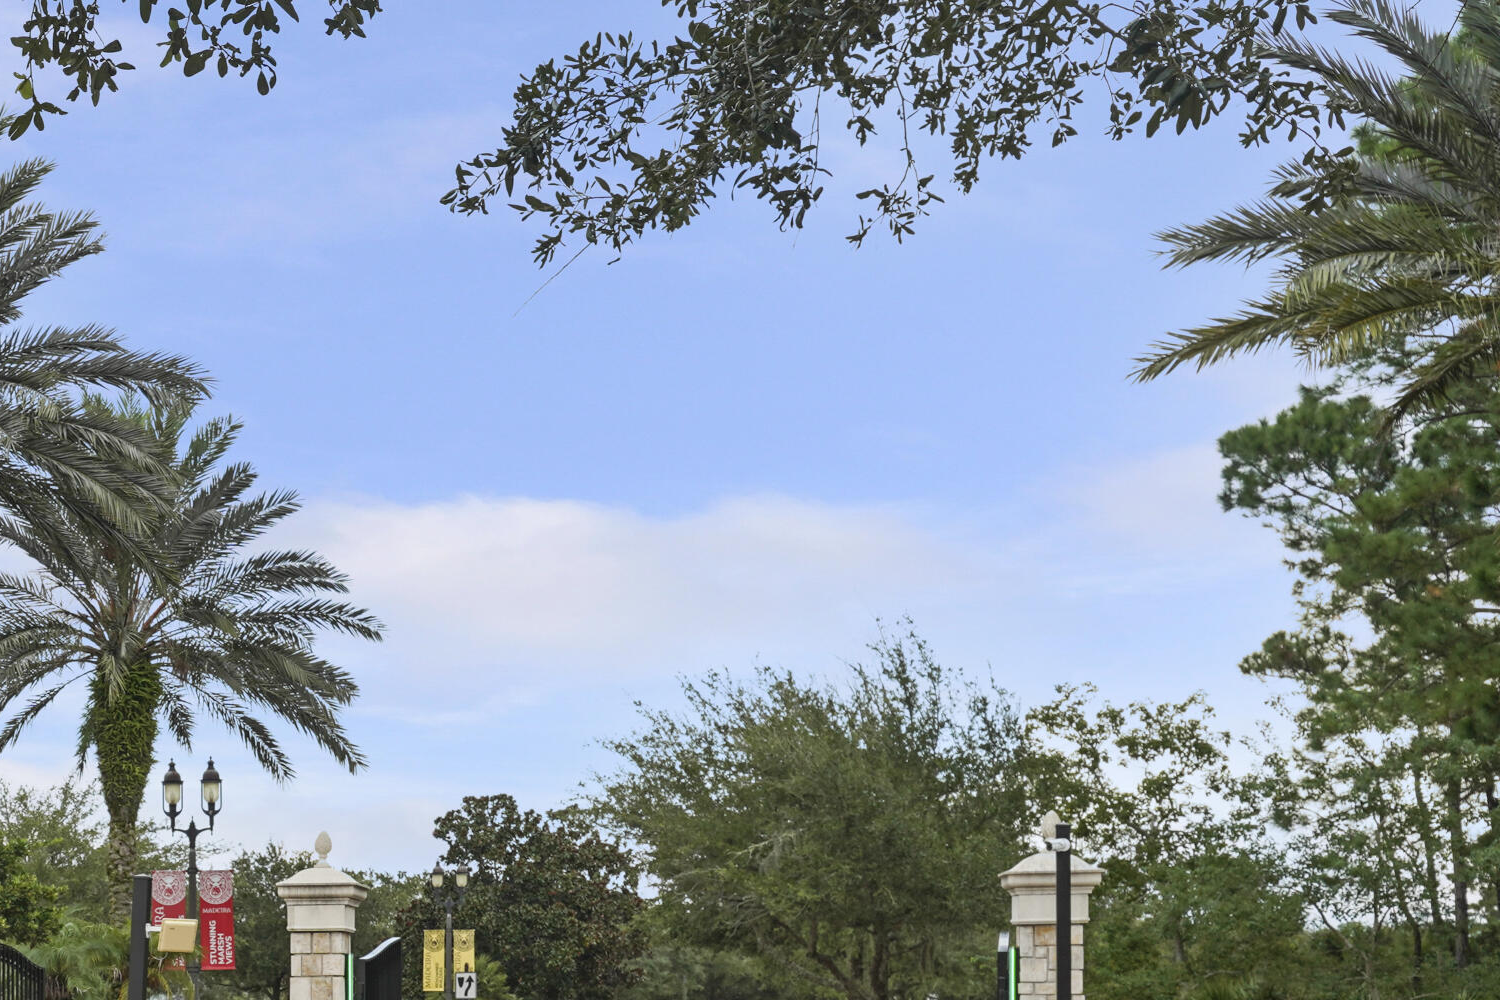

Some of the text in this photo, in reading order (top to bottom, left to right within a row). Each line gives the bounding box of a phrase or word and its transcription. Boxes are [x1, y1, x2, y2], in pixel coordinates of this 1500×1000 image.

[209, 920, 217, 965] STUNNING
[217, 933, 225, 965] MARSH
[225, 936, 233, 965] VIEWS
